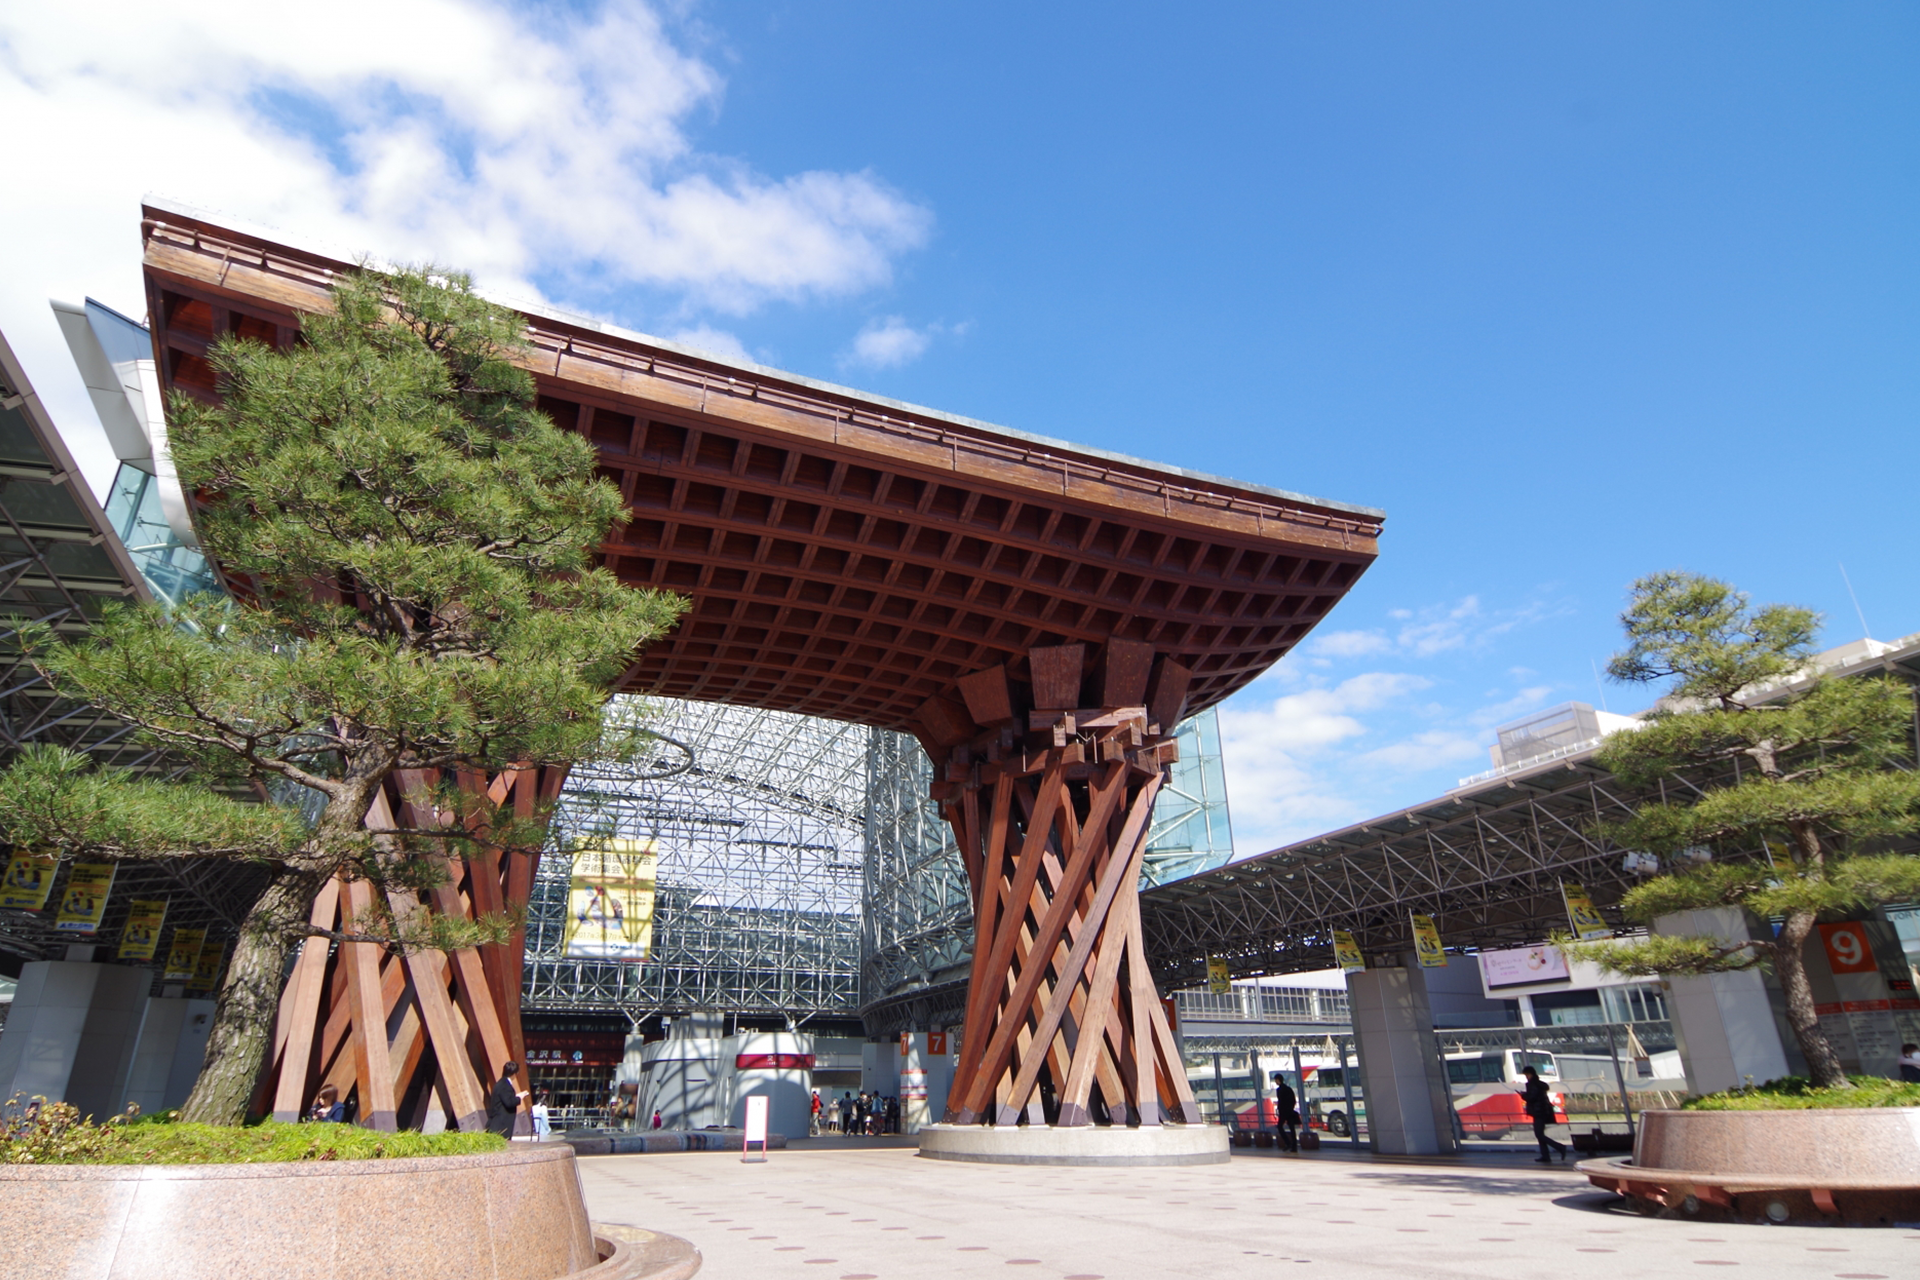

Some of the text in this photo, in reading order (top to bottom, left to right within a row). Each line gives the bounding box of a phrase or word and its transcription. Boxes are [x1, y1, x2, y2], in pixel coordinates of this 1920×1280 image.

[1831, 931, 1862, 965] 9
[902, 1036, 907, 1052] 7
[932, 1036, 942, 1051] 7
